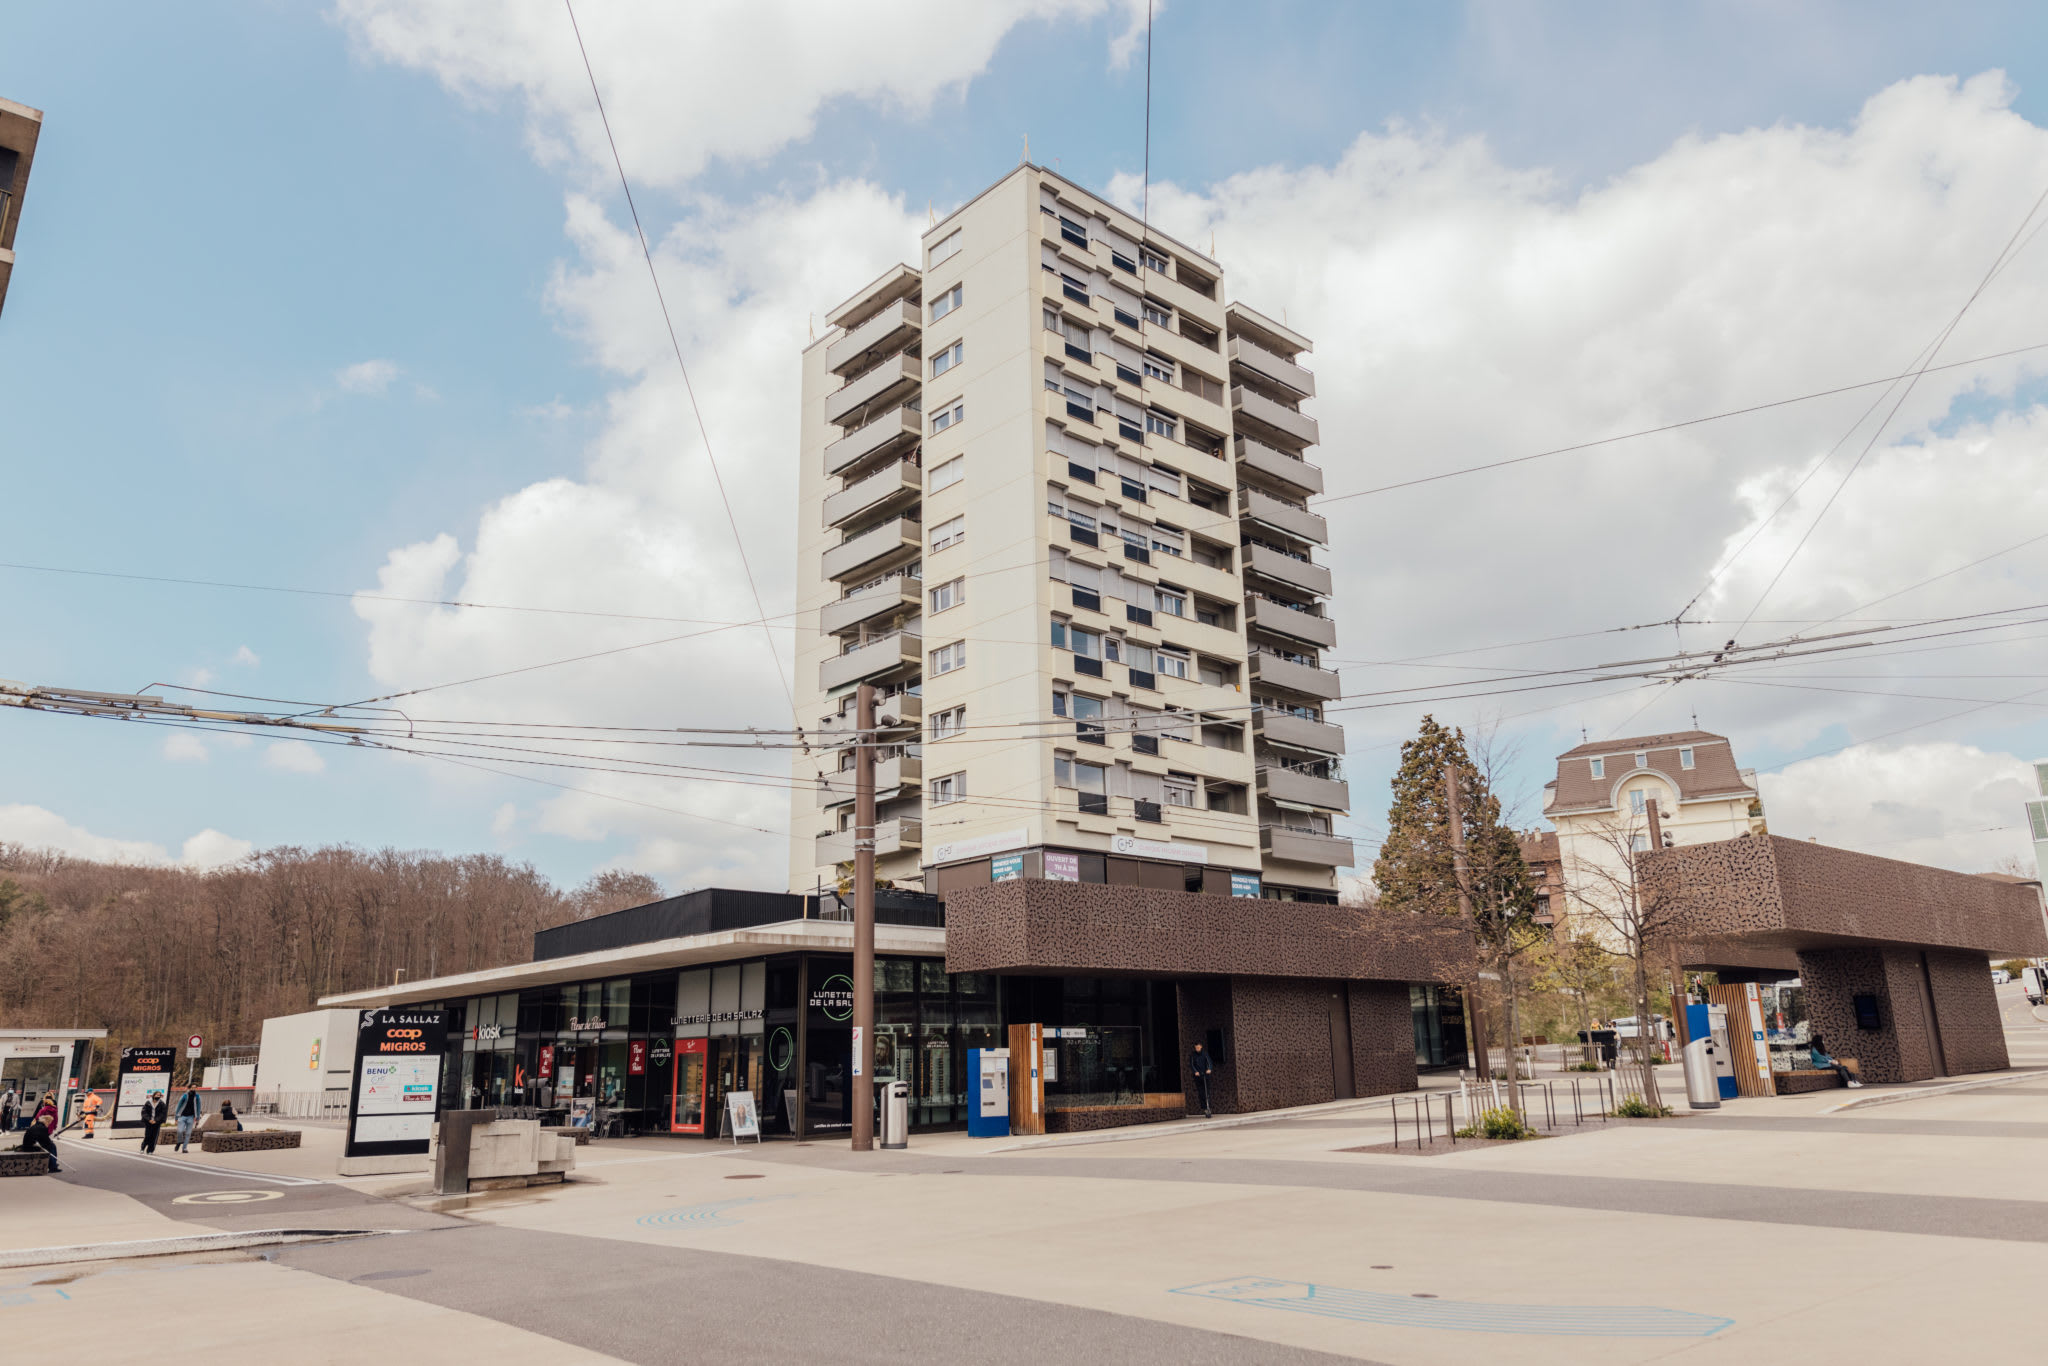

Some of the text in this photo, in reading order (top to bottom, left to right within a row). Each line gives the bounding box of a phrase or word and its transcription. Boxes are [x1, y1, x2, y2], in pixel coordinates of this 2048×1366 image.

[1047, 855, 1068, 863] OUVERT
[400, 1016, 440, 1024] SALLAZ
[671, 1010, 762, 1025] LUNETTERIE DE LA SALLAZ
[387, 1029, 422, 1040] coop
[479, 1024, 501, 1040] kiosk
[380, 1042, 426, 1051] MIGROS
